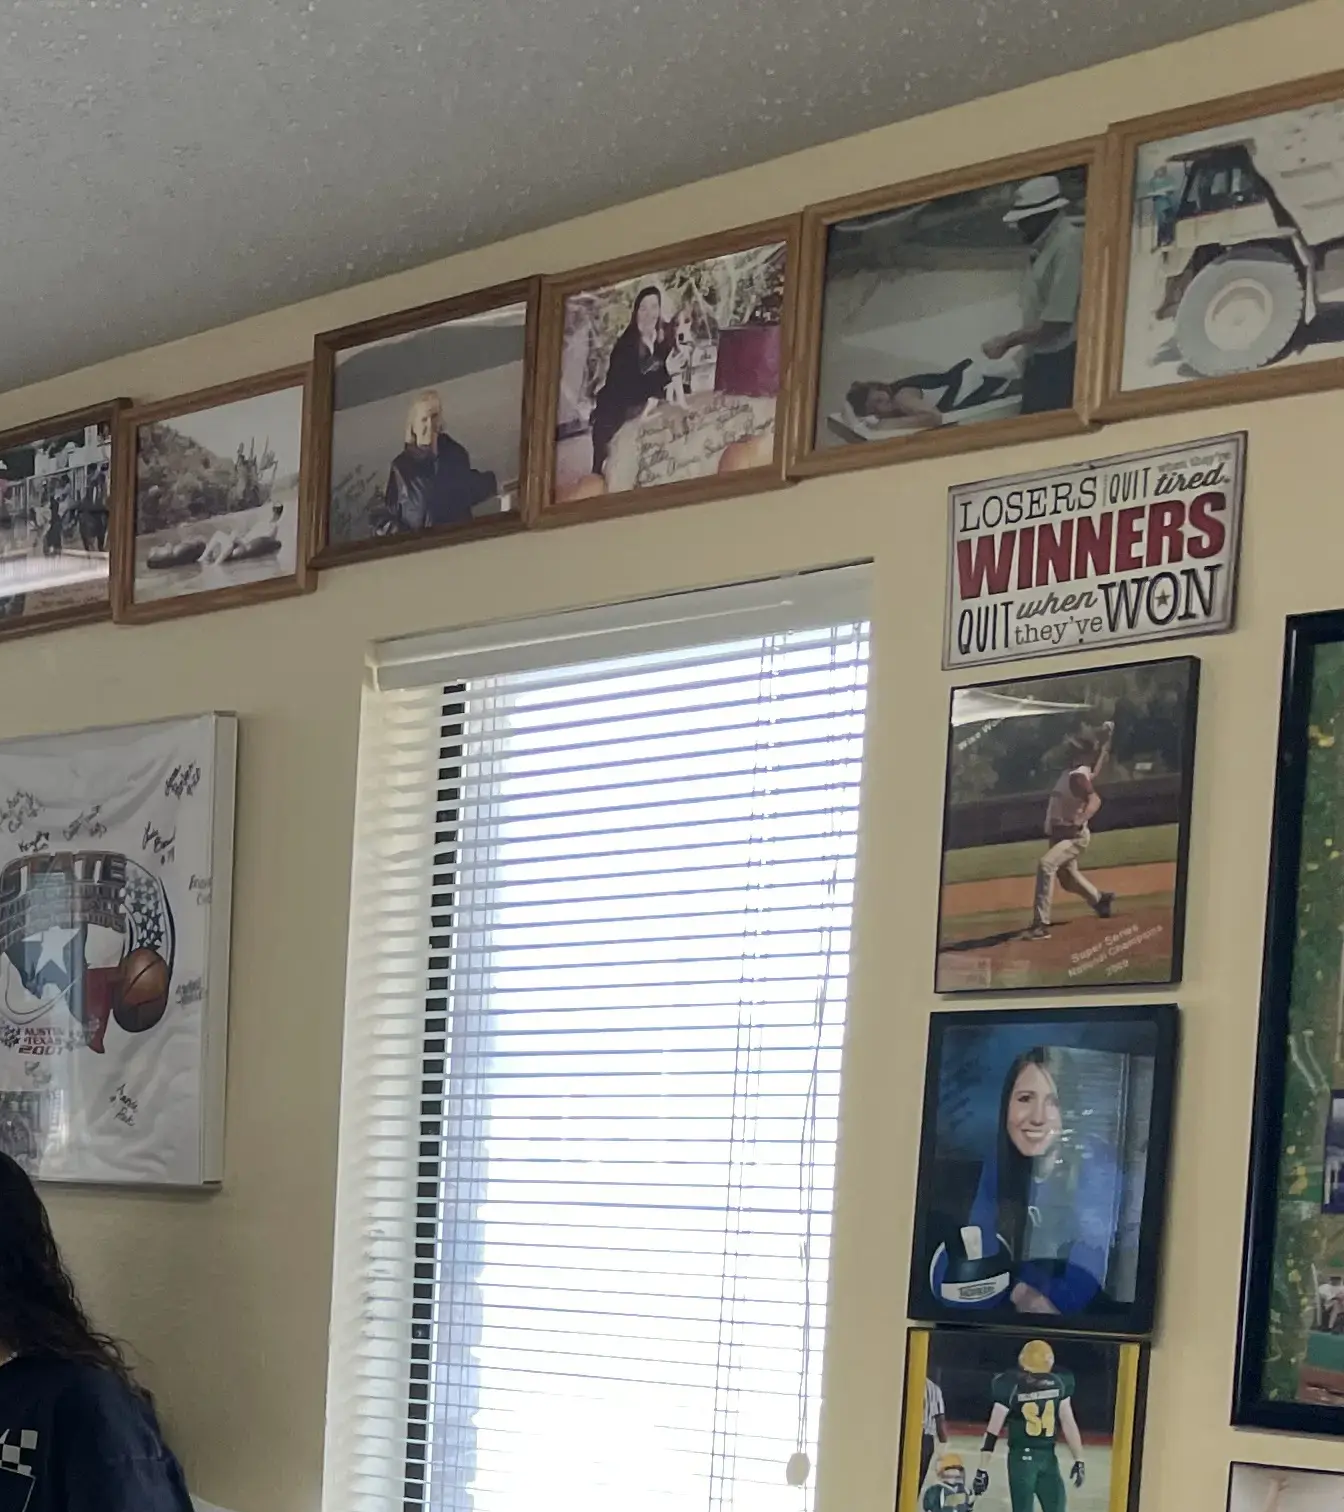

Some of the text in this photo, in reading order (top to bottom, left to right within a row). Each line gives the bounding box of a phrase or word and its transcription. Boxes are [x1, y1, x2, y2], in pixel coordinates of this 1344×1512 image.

[959, 467, 1152, 532] LOSERS QUIT
[1154, 462, 1231, 496] tired.
[957, 491, 1226, 600] WINNERS
[1015, 592, 1099, 620] when
[1097, 563, 1224, 633] WON
[958, 601, 1014, 655] QUIT
[1014, 616, 1103, 645] they've
